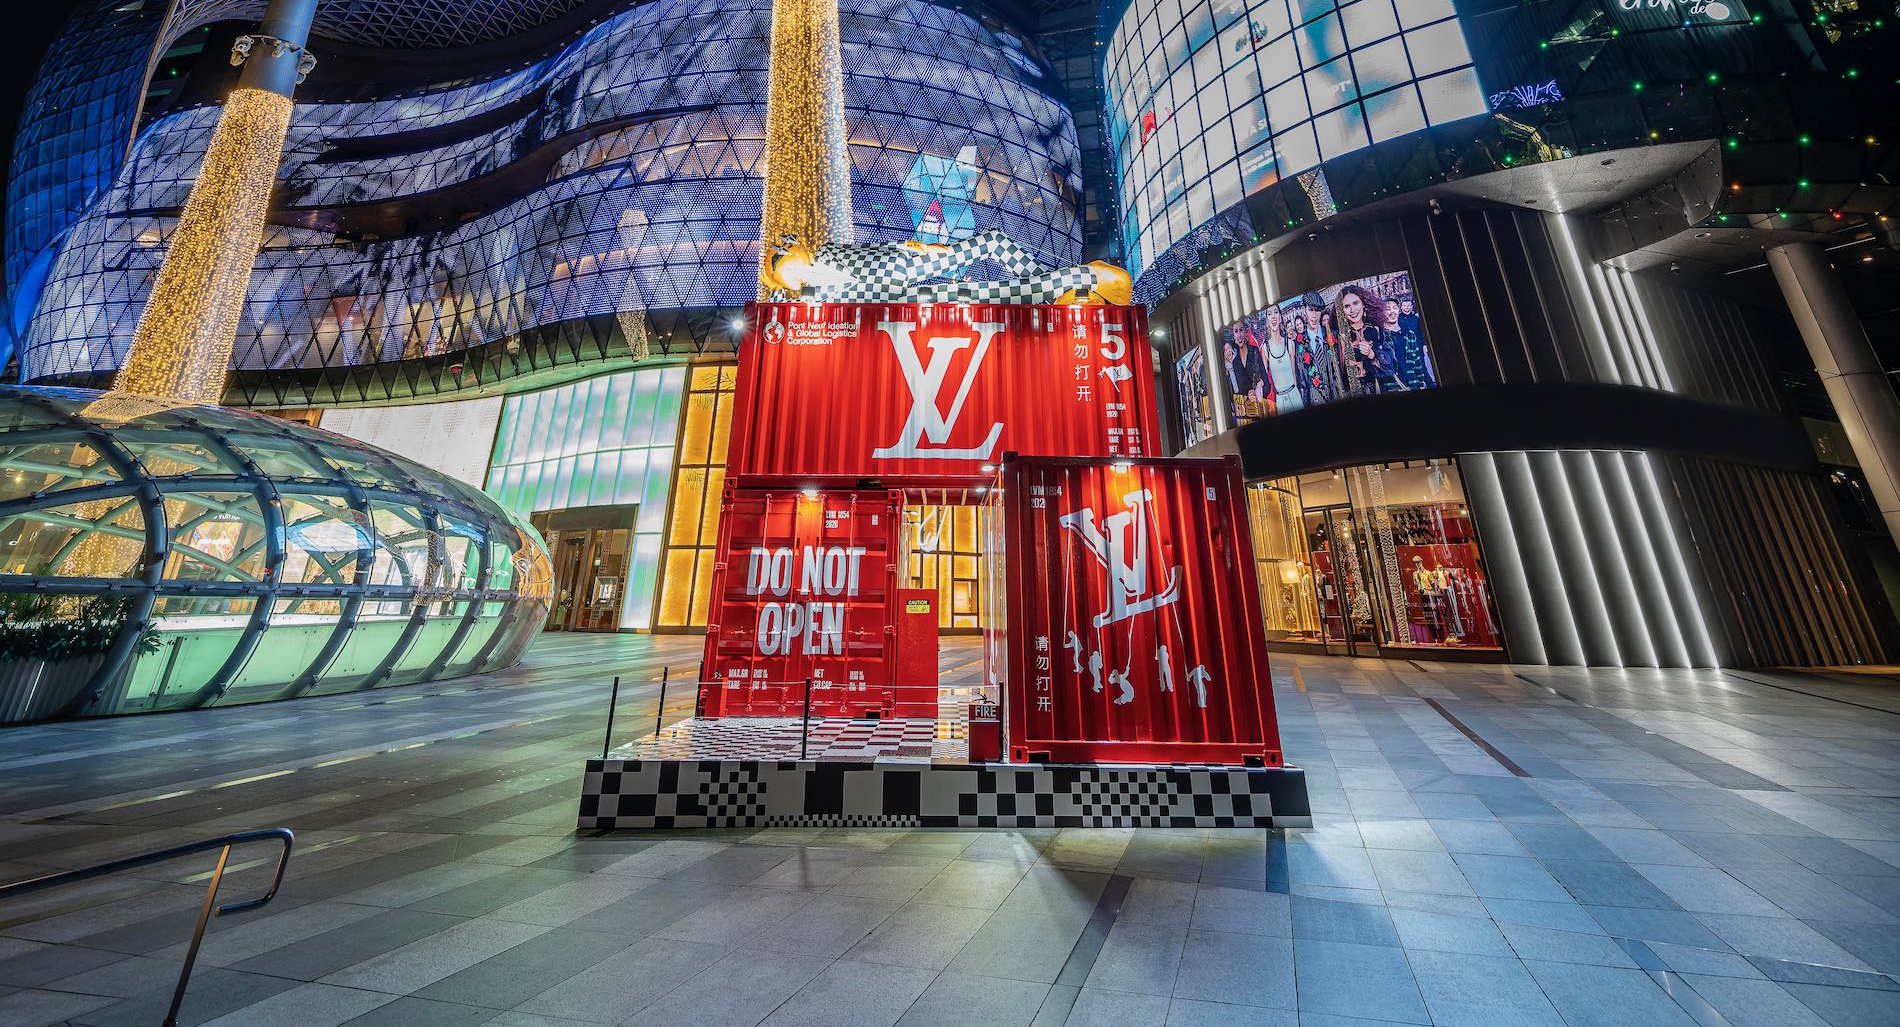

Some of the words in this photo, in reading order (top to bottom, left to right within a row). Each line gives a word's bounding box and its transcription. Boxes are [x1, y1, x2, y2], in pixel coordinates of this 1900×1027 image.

[788, 321, 805, 330] Pont
[808, 321, 826, 330] Neuf
[828, 321, 858, 330] Ideation
[787, 329, 793, 337] &
[796, 329, 821, 337] Global
[823, 330, 857, 339] Logistics
[786, 337, 833, 346] Corporation
[1100, 323, 1126, 360] 5
[1030, 485, 1044, 495] LVM
[825, 519, 839, 529] 2020
[747, 546, 794, 597] DO
[800, 545, 867, 597] NOT
[757, 602, 846, 656] OPEN
[813, 668, 825, 678] NET
[975, 705, 996, 717] FIRE
